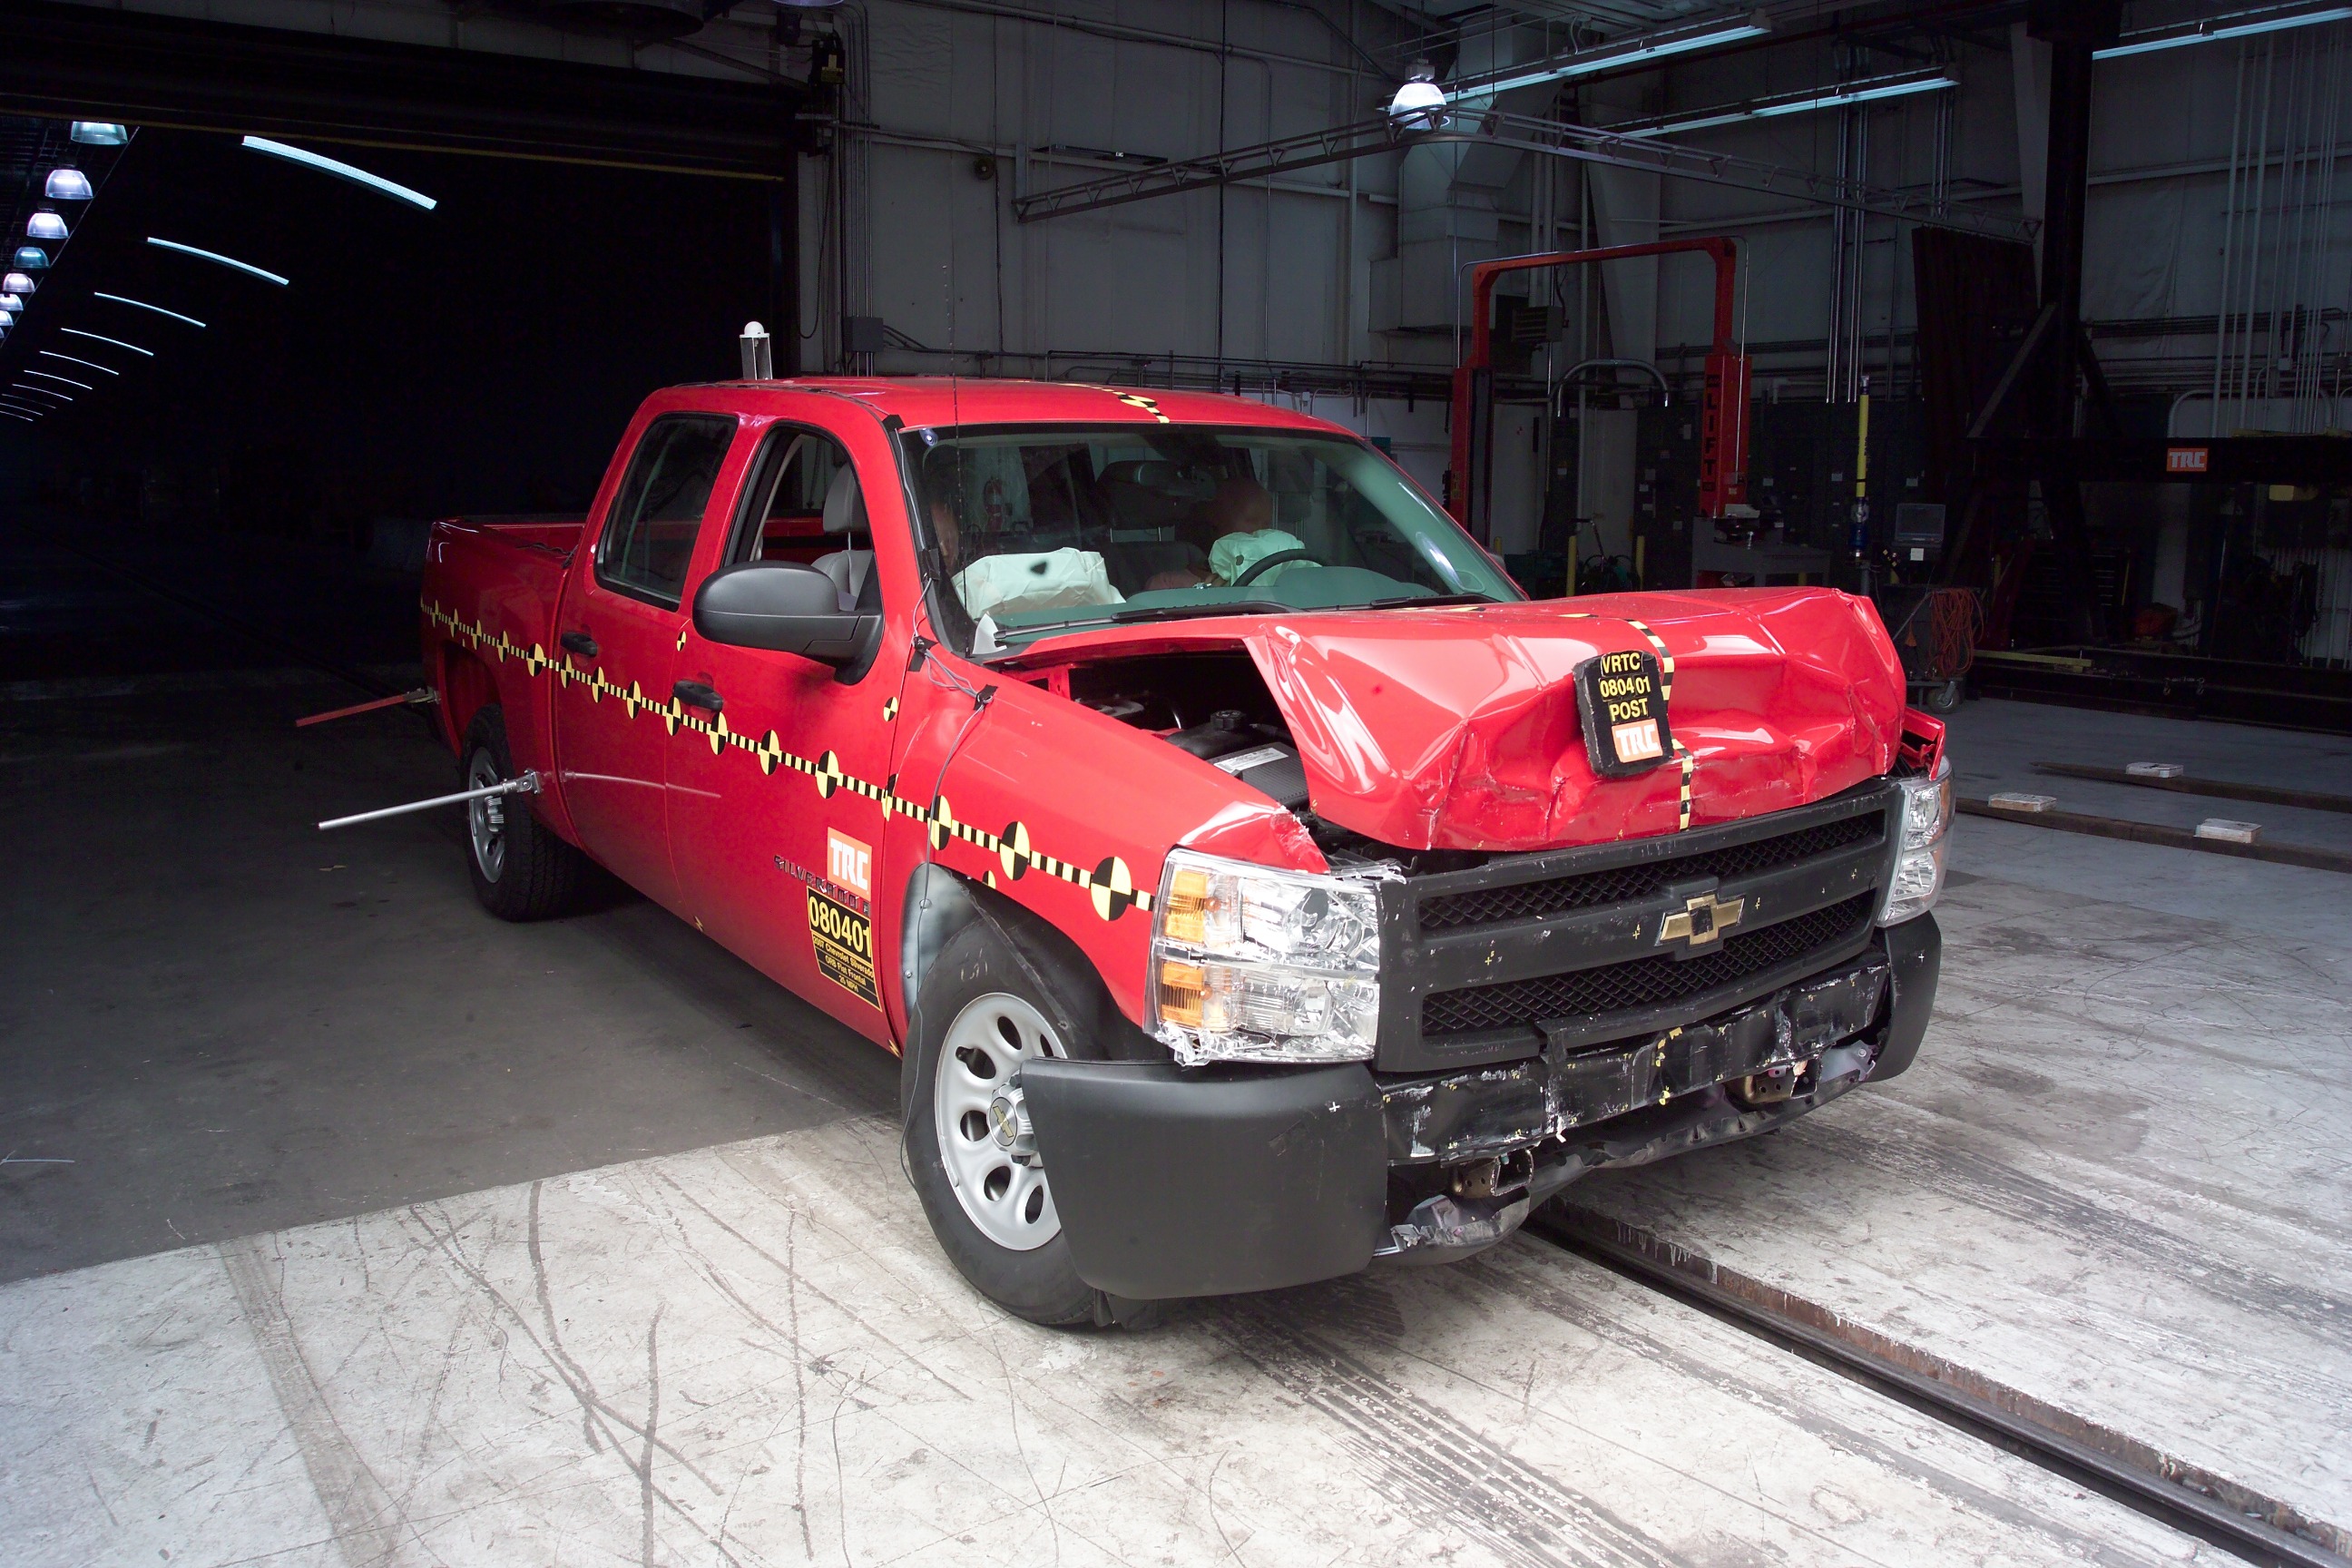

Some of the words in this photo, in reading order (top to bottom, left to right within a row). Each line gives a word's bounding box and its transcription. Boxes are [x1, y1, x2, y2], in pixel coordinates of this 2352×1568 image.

[1703, 392, 1717, 476] LIFT
[2170, 451, 2206, 468] TRC
[1602, 652, 1641, 673] VRTC
[1600, 676, 1651, 698] 080401
[1609, 698, 1648, 721] POST
[1615, 724, 1659, 756] TRC
[829, 838, 868, 891] TRC
[808, 896, 871, 958] 080401
